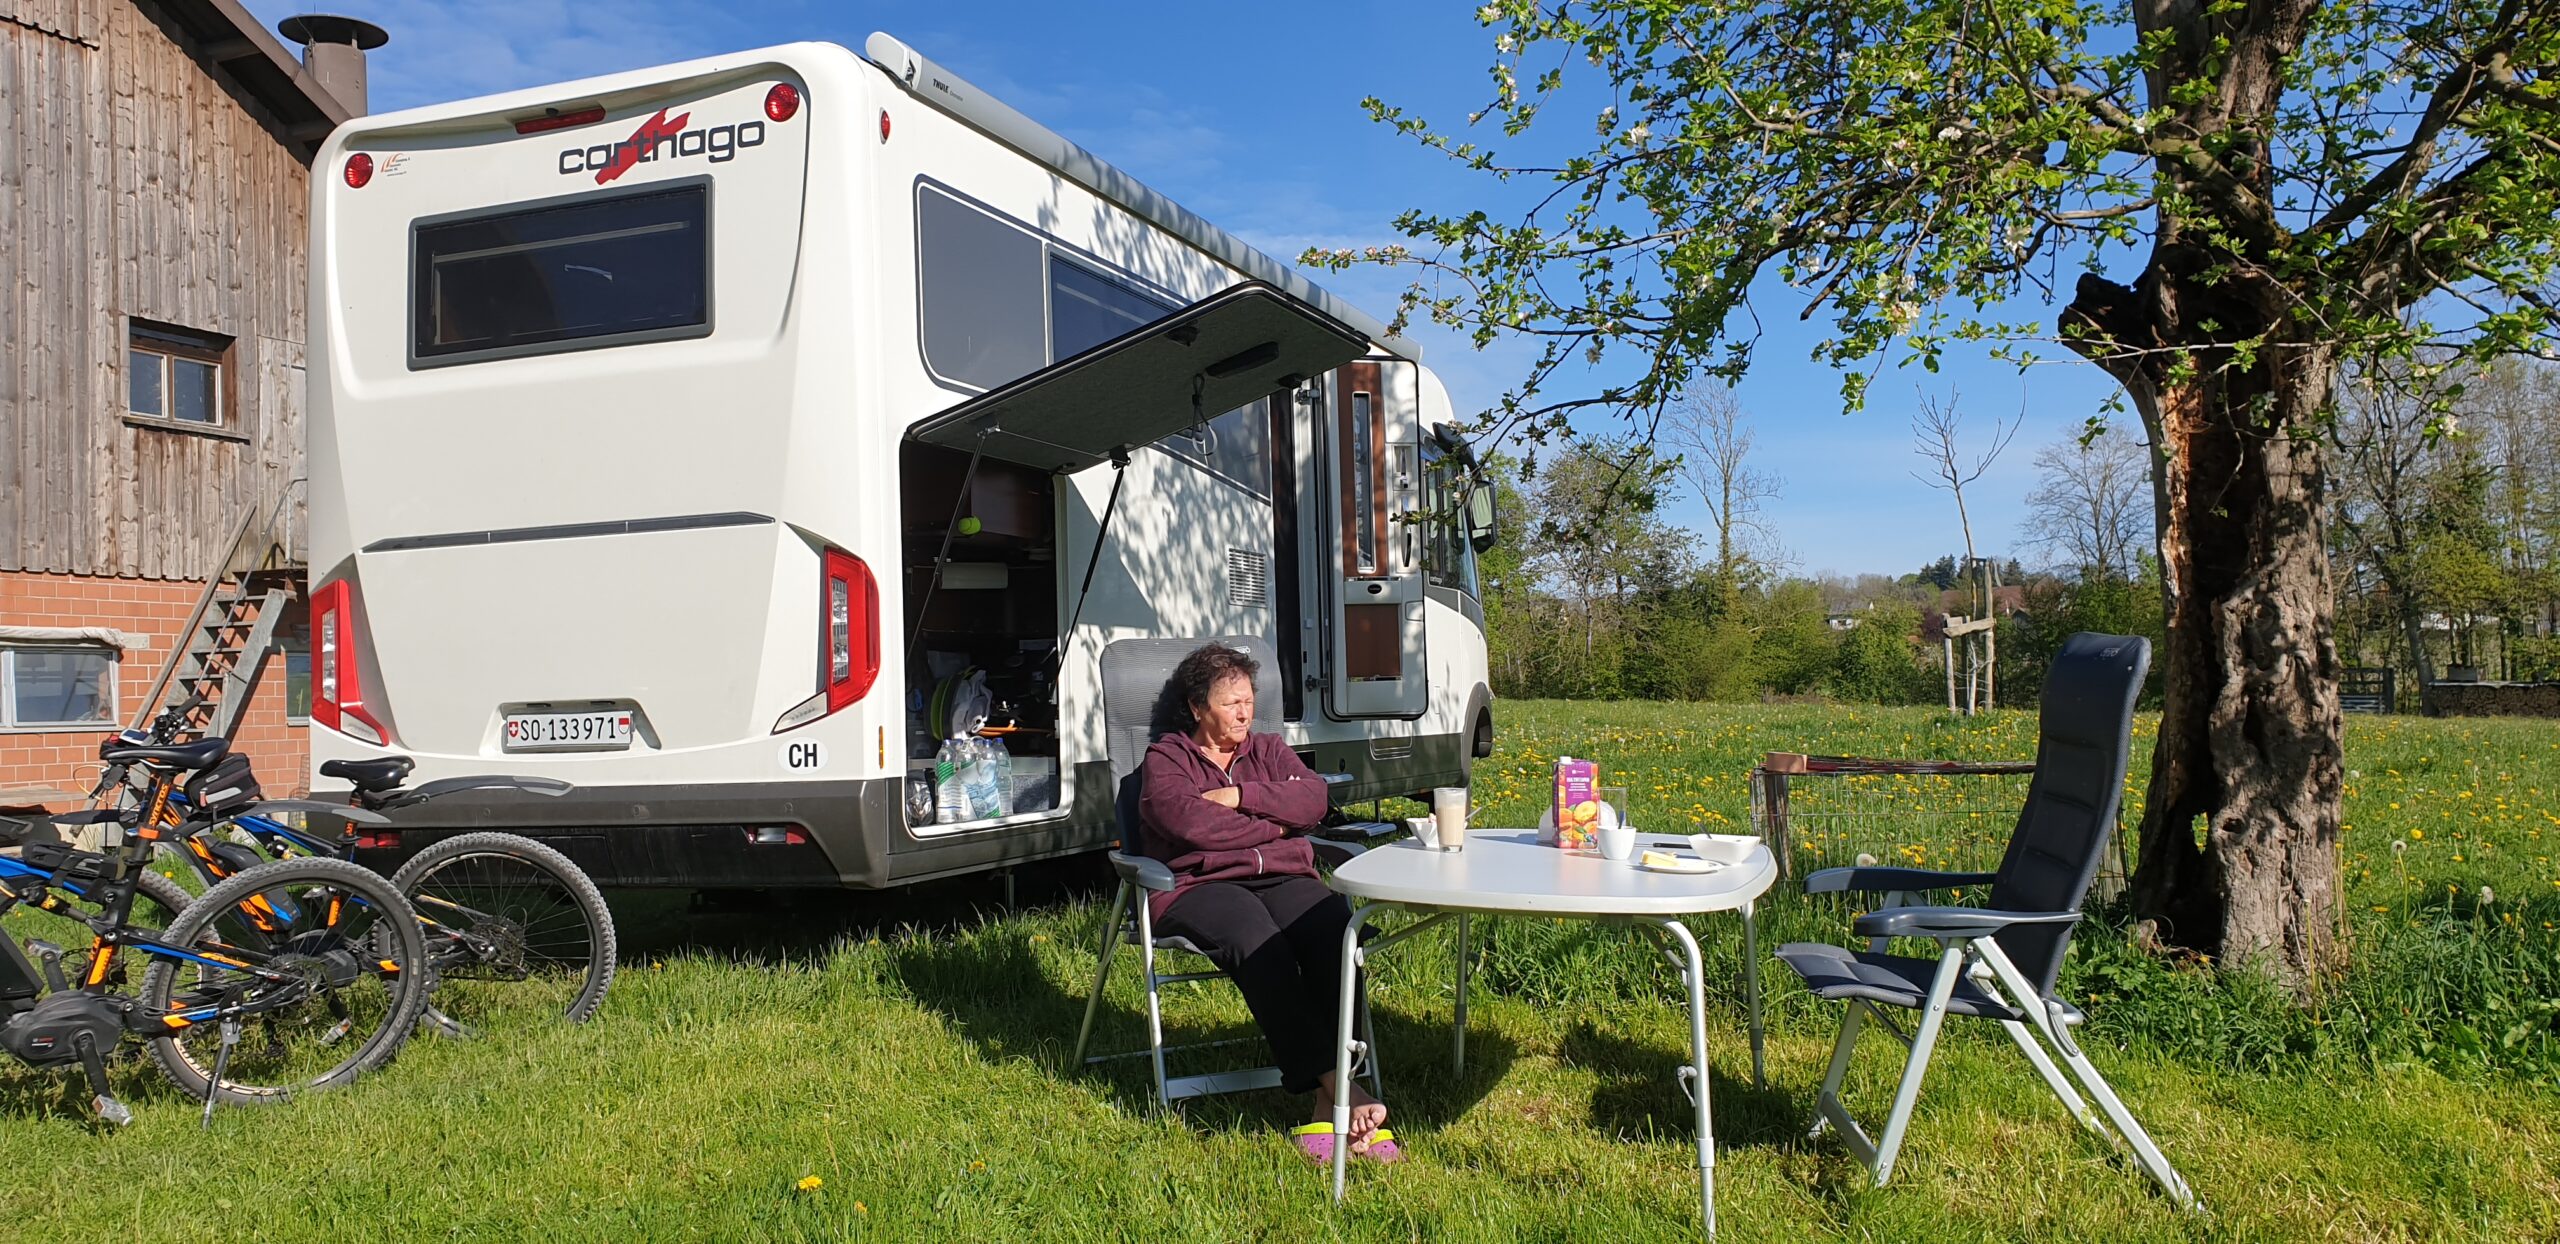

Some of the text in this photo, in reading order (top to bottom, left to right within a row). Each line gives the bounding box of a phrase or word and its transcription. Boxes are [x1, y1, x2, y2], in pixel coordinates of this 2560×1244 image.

[932, 78, 949, 94] THULE
[559, 120, 765, 175] carthago
[788, 743, 818, 768] CH
